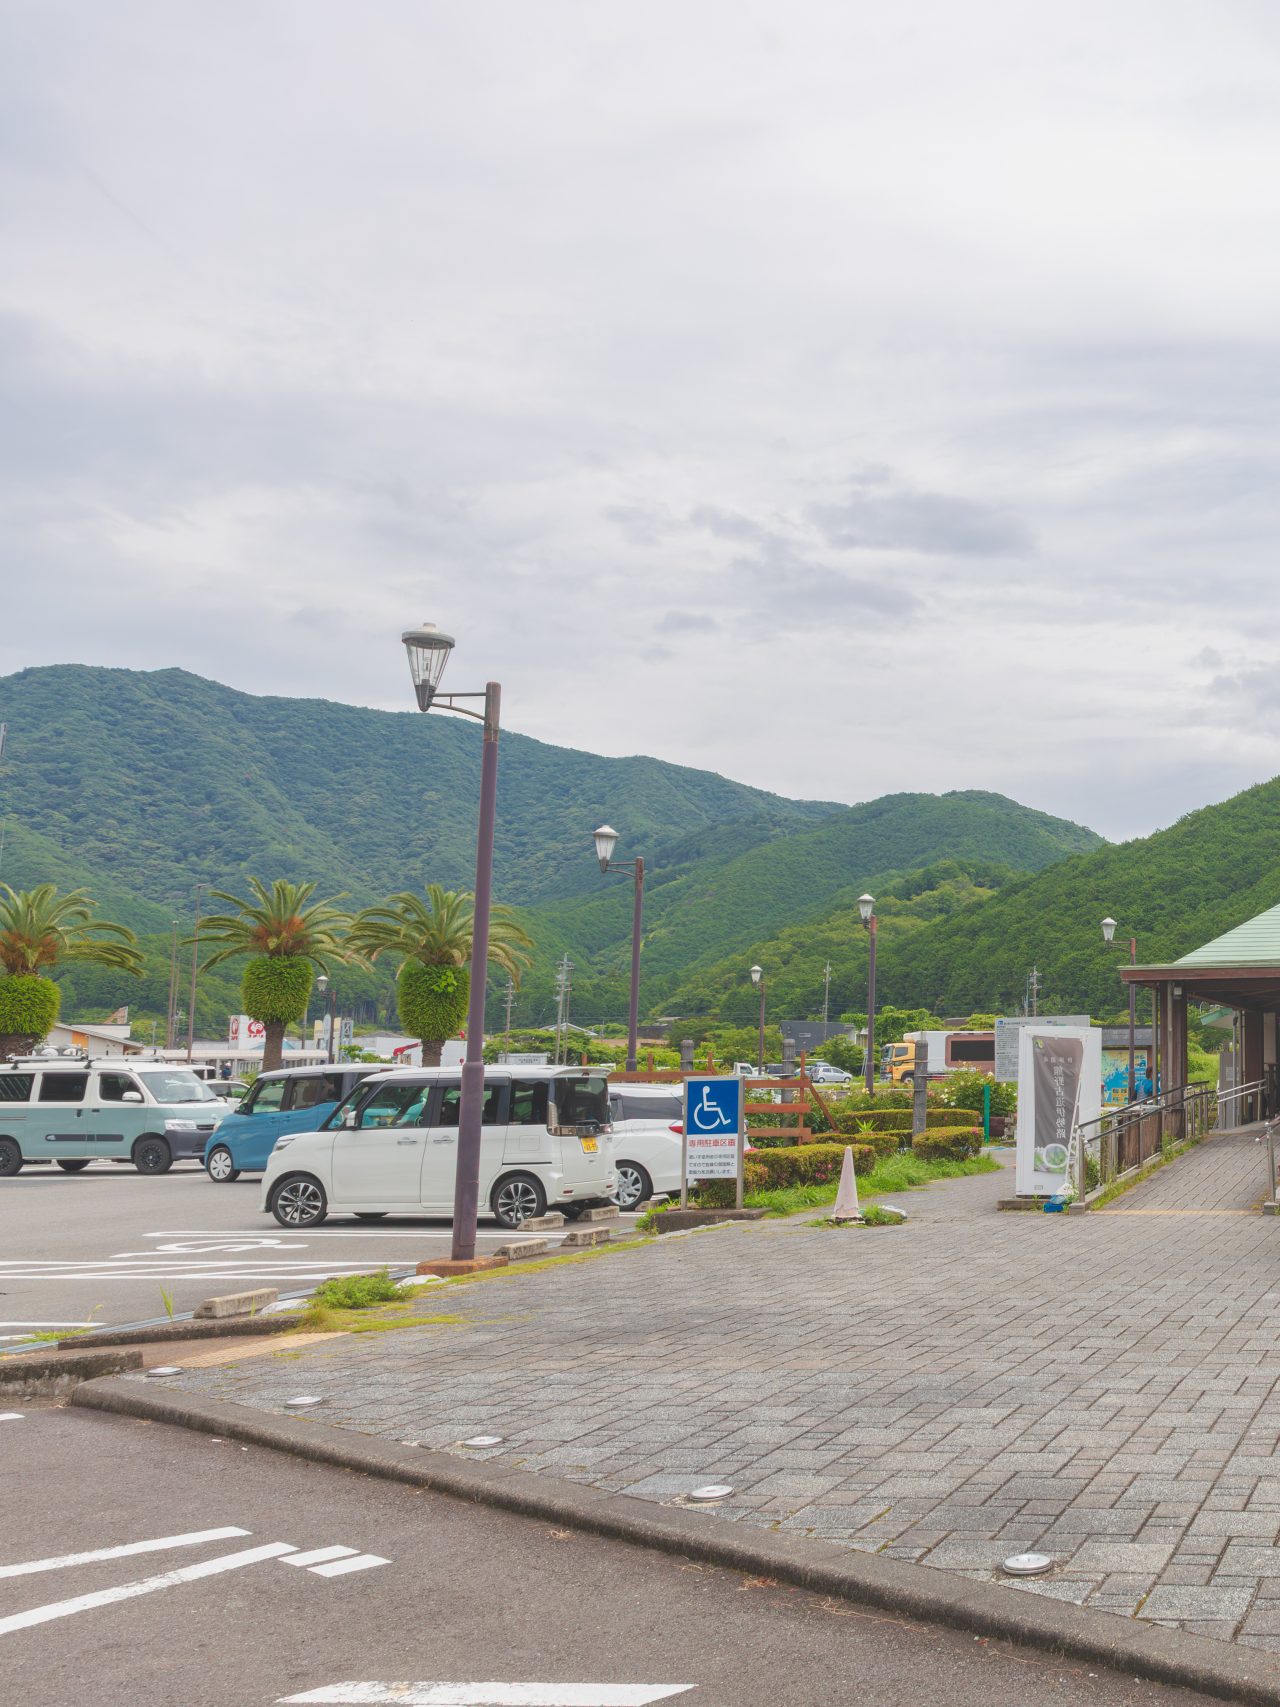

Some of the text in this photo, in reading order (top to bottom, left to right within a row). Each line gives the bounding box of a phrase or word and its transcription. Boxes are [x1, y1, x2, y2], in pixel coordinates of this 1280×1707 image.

[688, 1138, 736, 1147] 専用駐車区画
